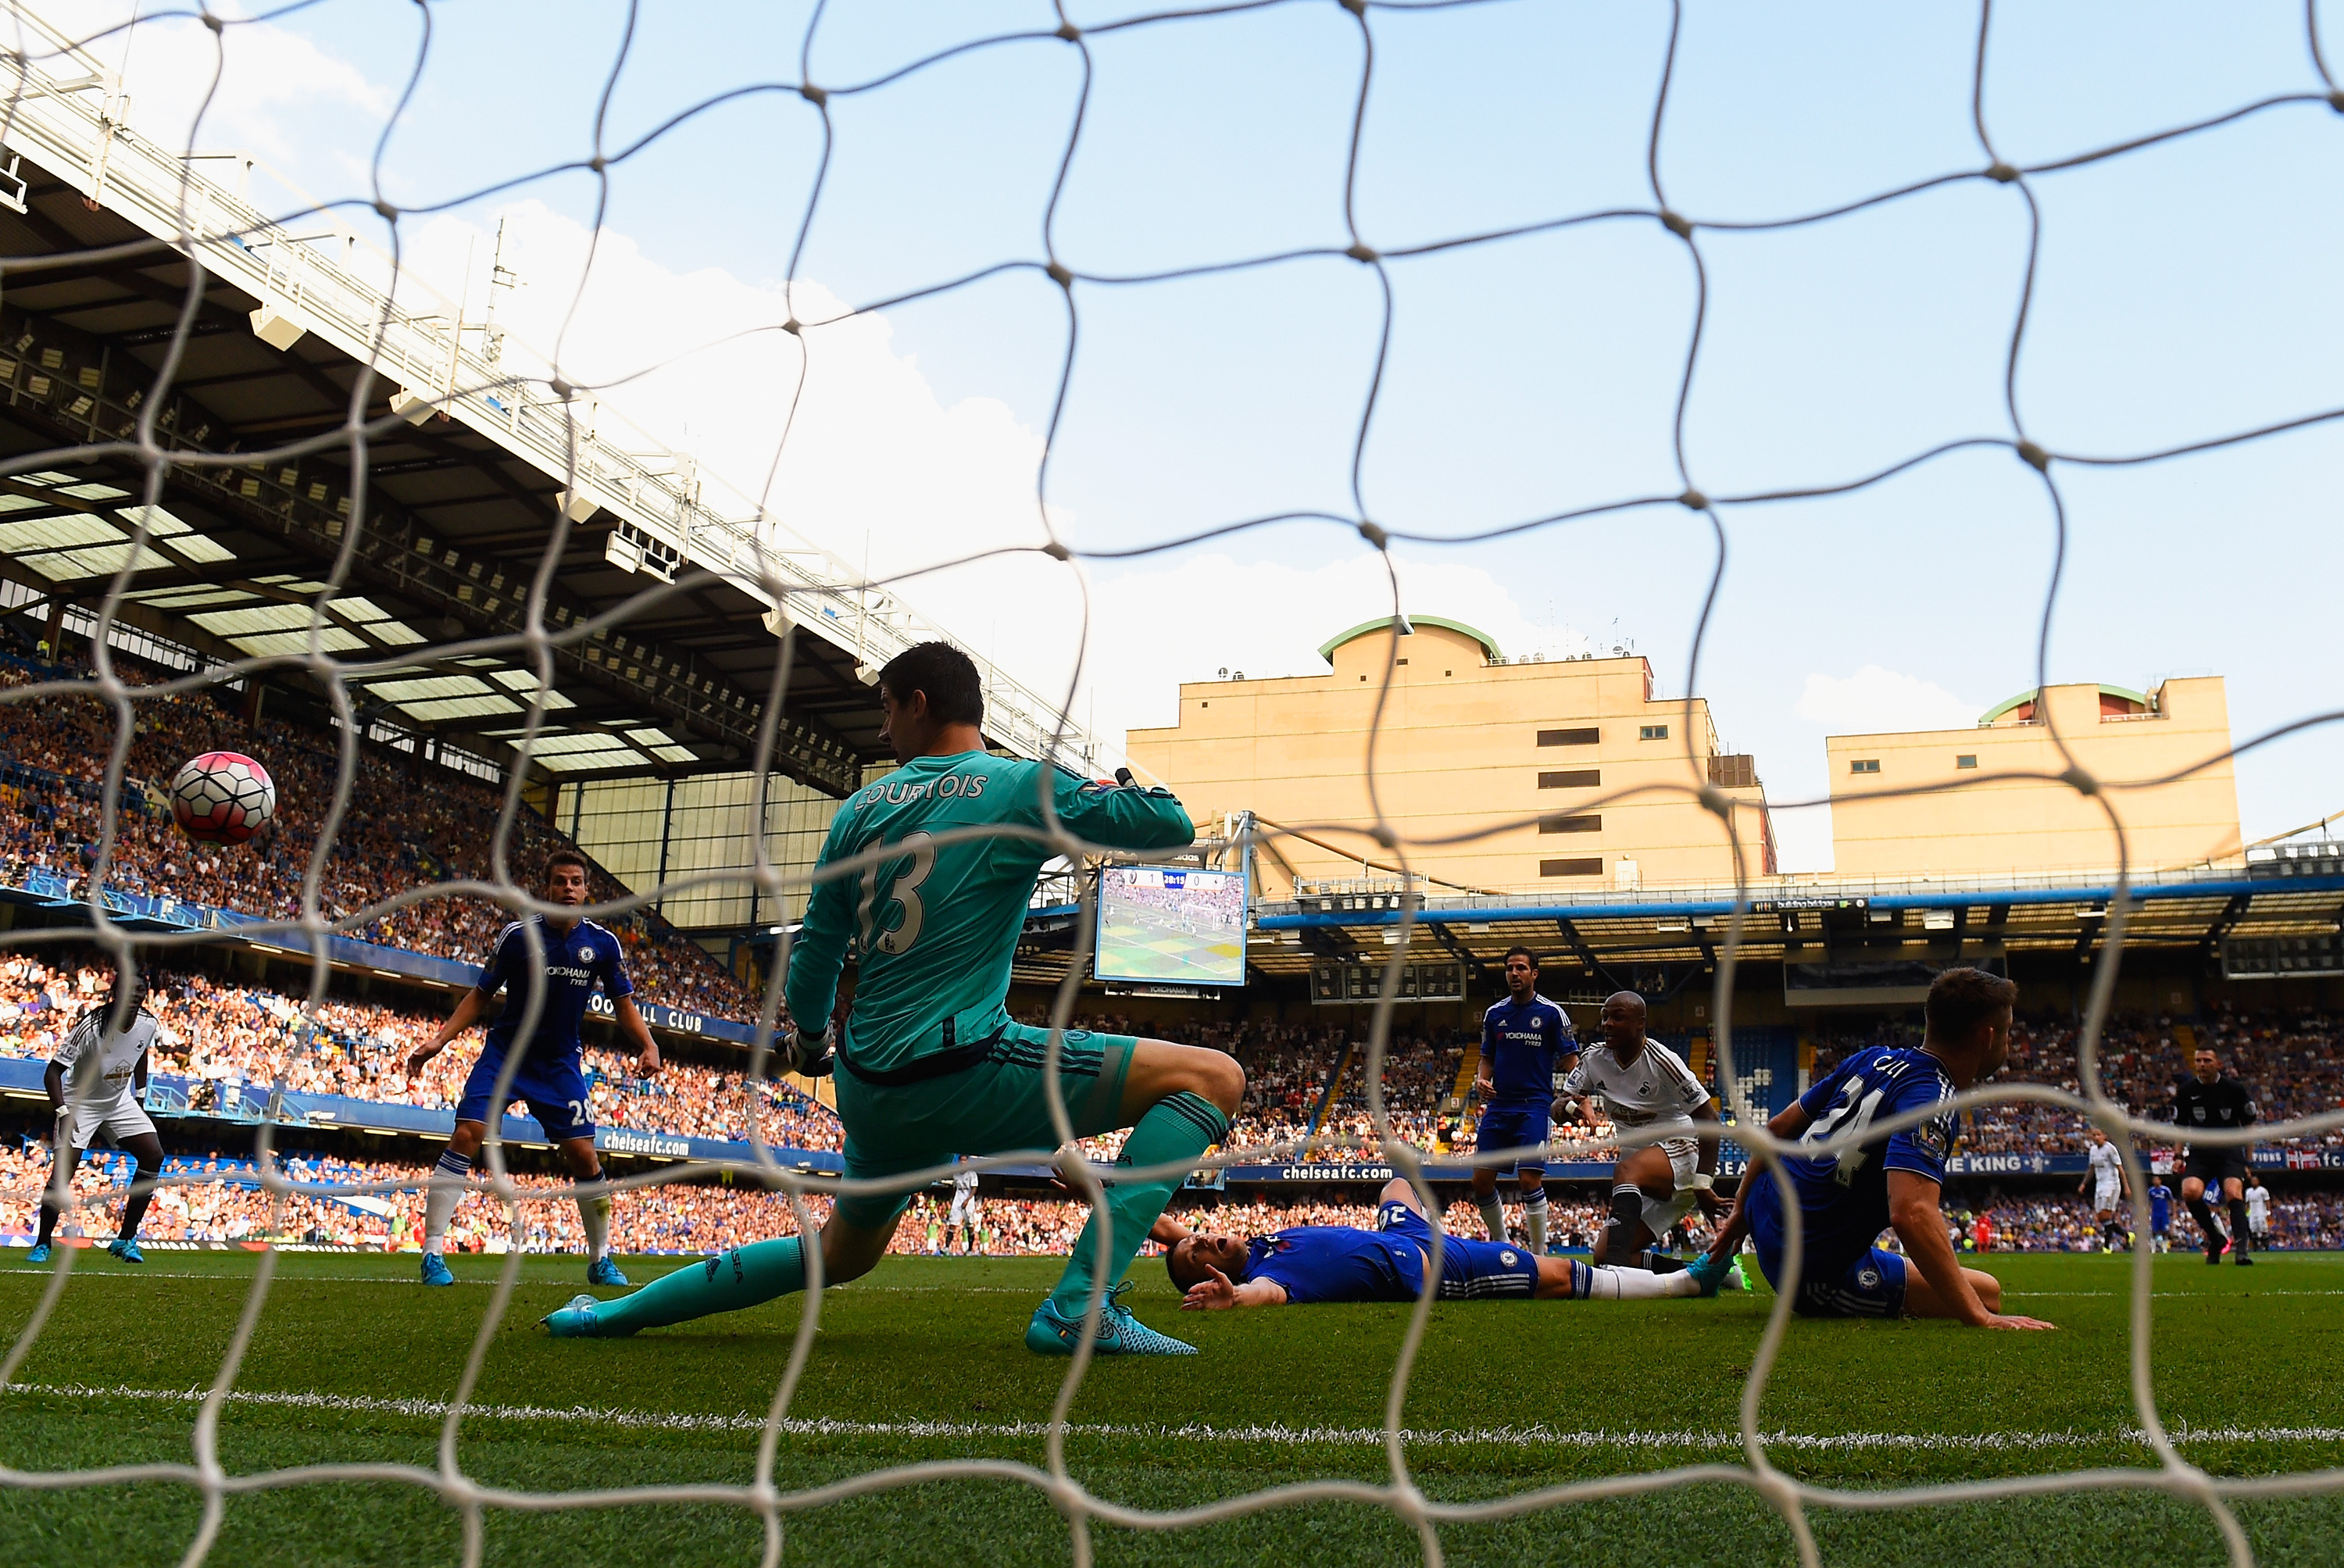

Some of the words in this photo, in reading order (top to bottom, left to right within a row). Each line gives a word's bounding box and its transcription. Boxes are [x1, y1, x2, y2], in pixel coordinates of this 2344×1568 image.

[1149, 873, 1154, 884] 1
[1193, 875, 1199, 886] 0
[857, 830, 937, 955] 13
[1150, 985, 1187, 994] YOKOHAMA
[668, 1011, 702, 1032] CLUB
[1505, 1032, 1542, 1041] YOKOHAMA
[1452, 1097, 1459, 1106] 3
[567, 1098, 594, 1127] 28
[604, 1131, 689, 1156] chelseafc.com
[1970, 1155, 2022, 1172] KING
[1282, 1165, 1393, 1180] chelseafc.com
